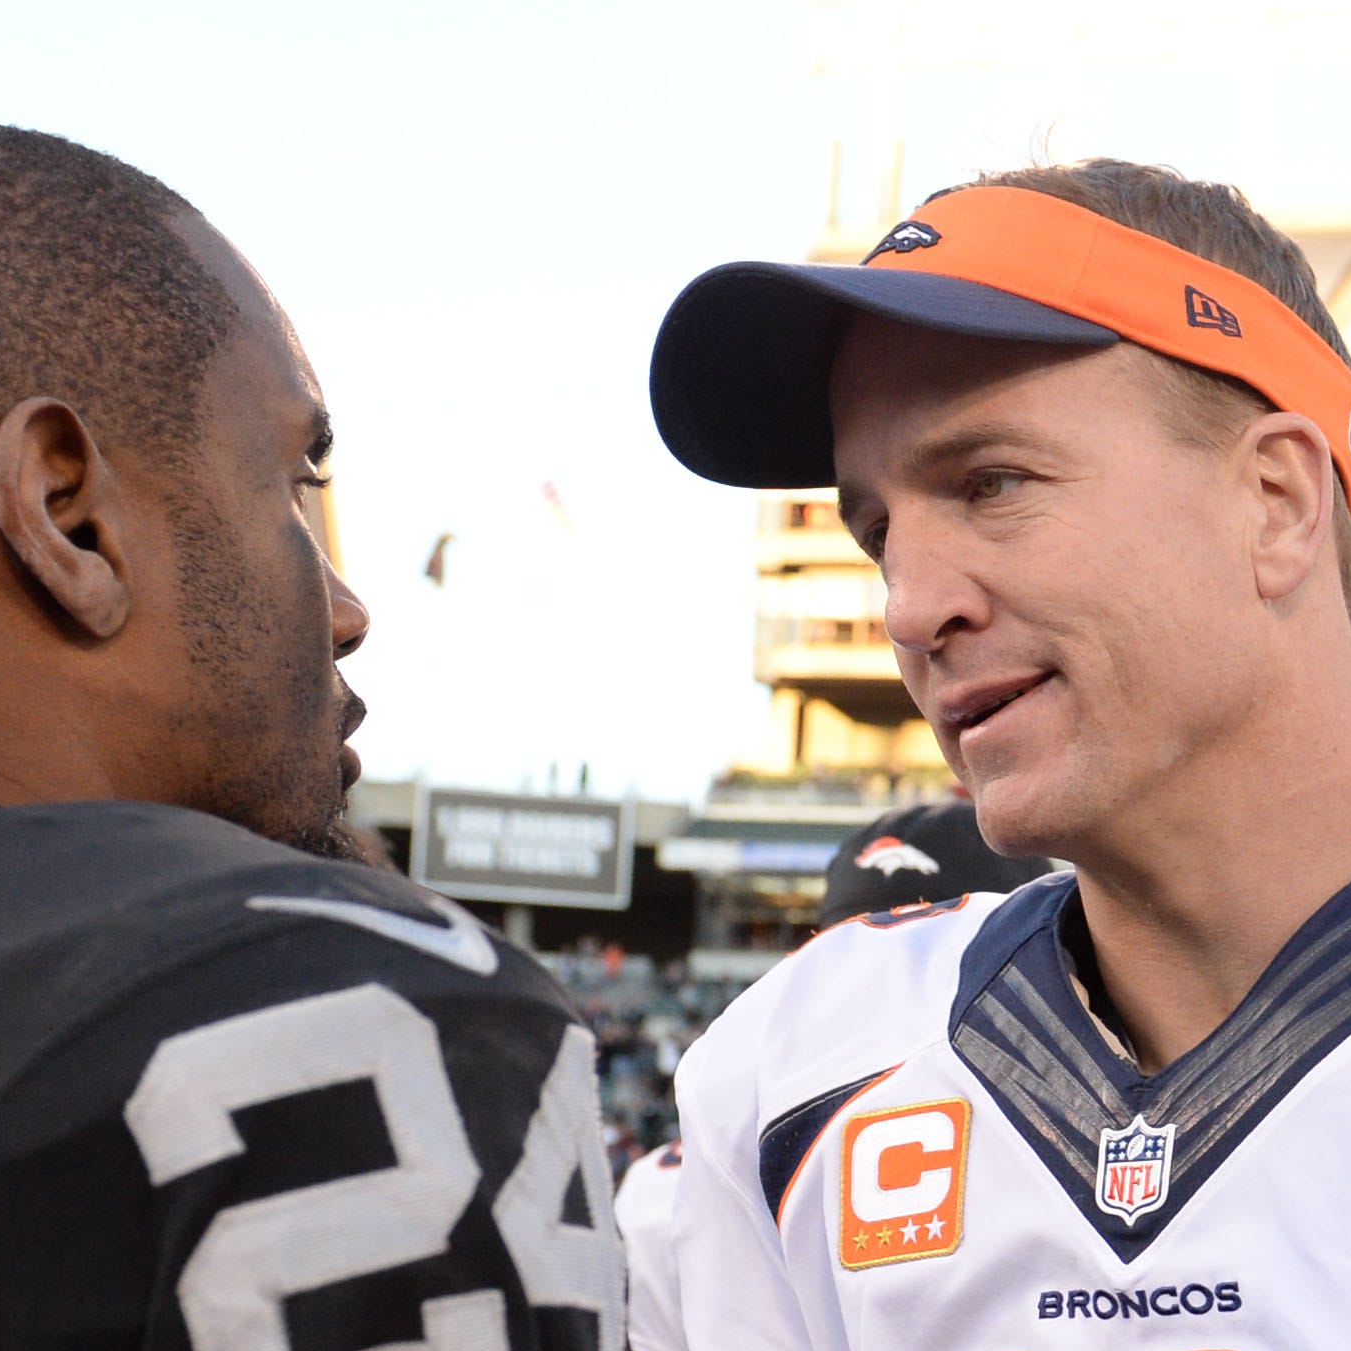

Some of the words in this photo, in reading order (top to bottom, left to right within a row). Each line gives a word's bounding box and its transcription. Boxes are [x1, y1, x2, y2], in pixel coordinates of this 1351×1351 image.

[850, 1110, 957, 1224] C
[1107, 1160, 1161, 1206] NFL
[1037, 1280, 1243, 1321] BRONCOS
